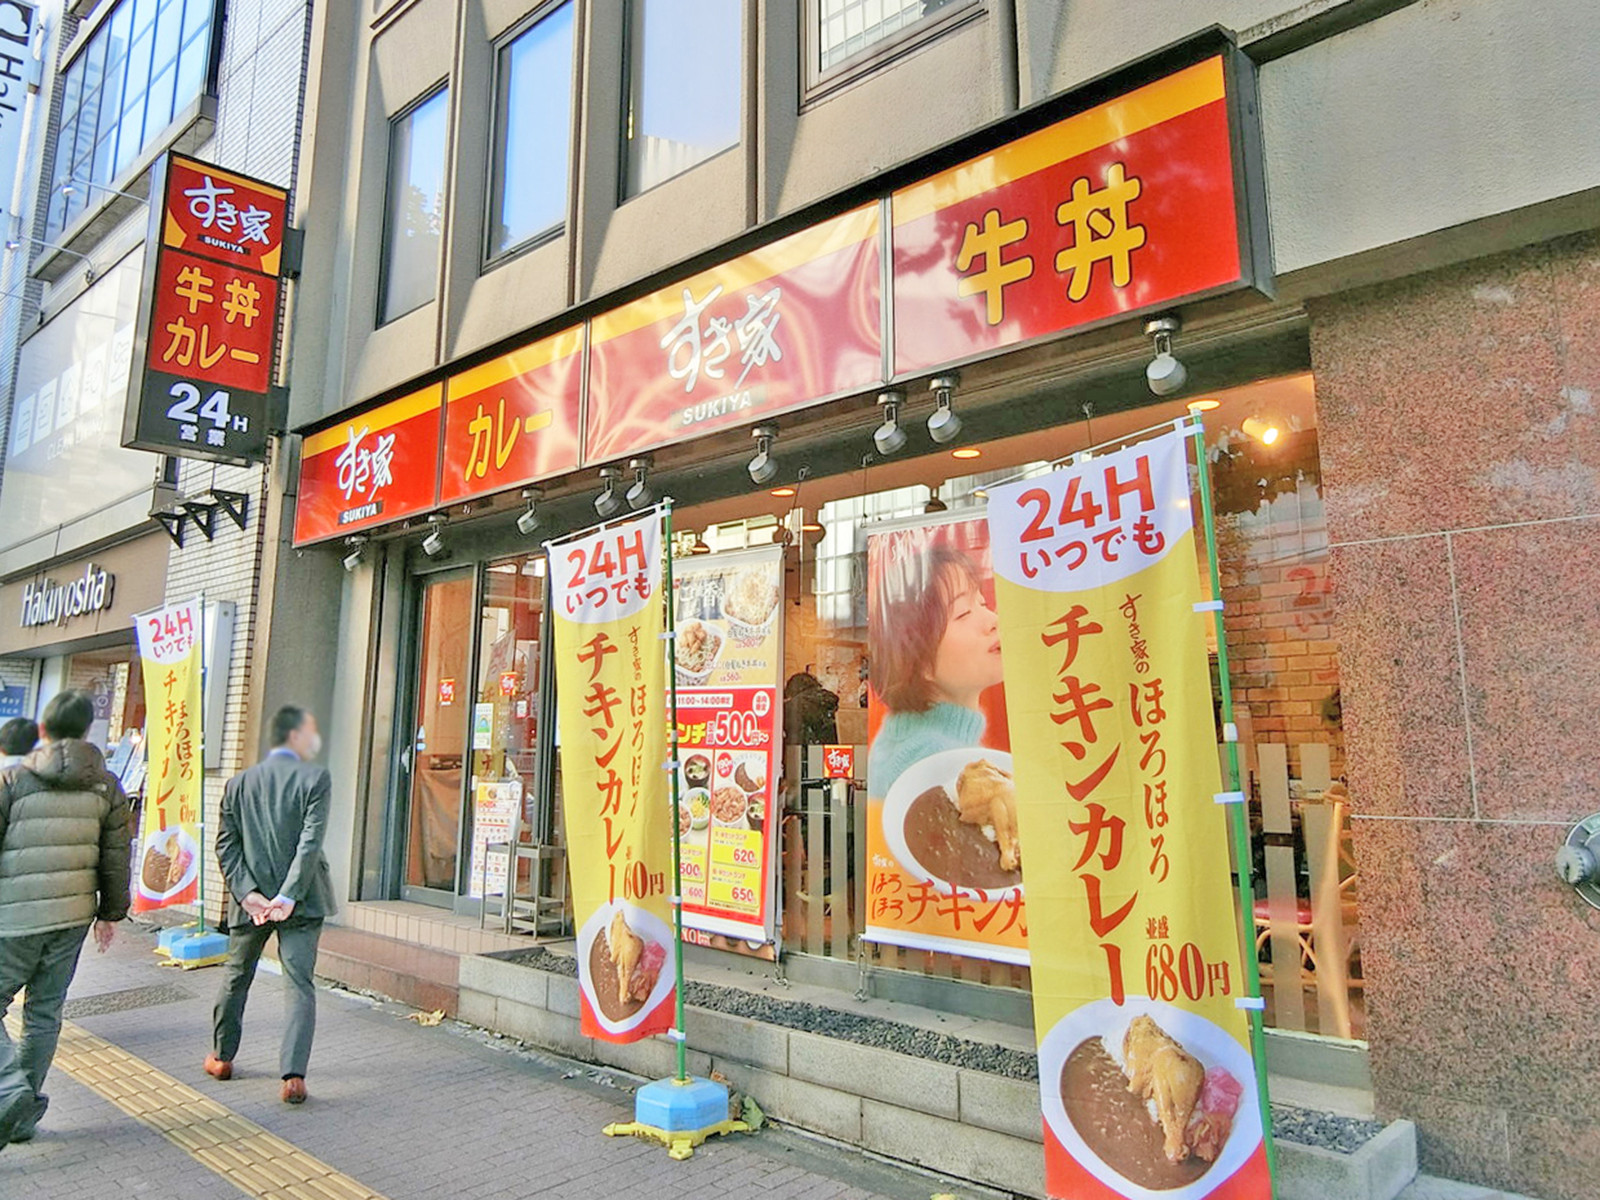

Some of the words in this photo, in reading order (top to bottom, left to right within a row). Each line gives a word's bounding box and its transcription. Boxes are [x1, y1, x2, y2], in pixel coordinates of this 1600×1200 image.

[183, 176, 272, 245] すき家
[204, 236, 244, 254] SUKIYA
[955, 162, 1146, 325] 牛丼
[175, 266, 261, 328] 牛丼
[163, 316, 260, 369] カレー
[660, 284, 782, 393] すき家
[167, 382, 249, 433] 24H
[179, 423, 227, 447] 営業
[682, 391, 752, 426] SUKIYA
[335, 425, 396, 502] すき家
[464, 398, 552, 483] カレー
[342, 502, 377, 525] SUKIYA
[1016, 455, 1155, 543] 24H
[567, 529, 648, 589] 24H
[1020, 516, 1165, 579] いつでも
[20, 562, 109, 628] Hakuyosha
[566, 572, 651, 614] いつでも
[148, 607, 193, 643] 24H
[1119, 593, 1150, 674] すき家の
[577, 632, 625, 906] チキンカレー
[1129, 678, 1169, 884] ほろほろ
[1041, 604, 1139, 1007] チキンカレー
[871, 872, 903, 895] ほろ
[872, 897, 904, 920] ほろ
[1145, 915, 1170, 940] 並盛
[1145, 942, 1231, 1002] 680円
